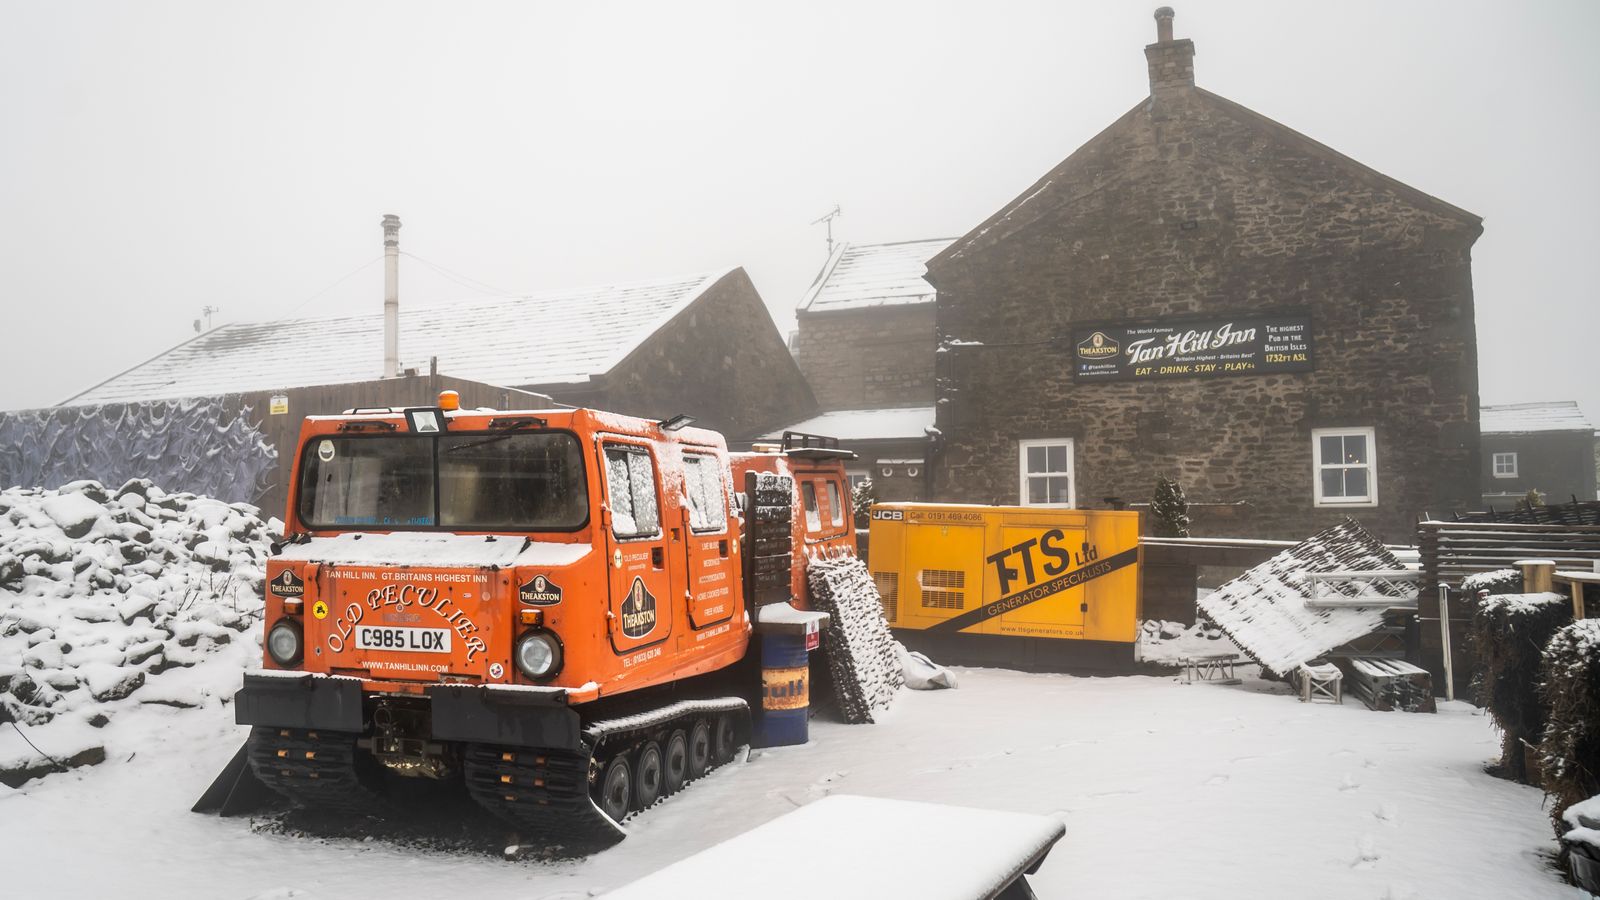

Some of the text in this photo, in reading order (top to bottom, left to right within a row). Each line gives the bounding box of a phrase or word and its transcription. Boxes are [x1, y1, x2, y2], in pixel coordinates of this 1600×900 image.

[1079, 346, 1117, 355] THEAKSTON
[1127, 322, 1257, 366] Tan Hill Inn
[1293, 353, 1307, 361] ASL
[1135, 367, 1152, 376] EAT
[1194, 363, 1217, 373] STAY
[1224, 362, 1247, 371] PLAY
[873, 511, 903, 520] JCB
[986, 528, 1070, 596] FTS
[1075, 545, 1098, 567] Ltd
[325, 570, 341, 579] TAN
[342, 571, 360, 579] HILL
[434, 574, 471, 583] HIGHEST
[473, 575, 488, 583] INN
[271, 584, 304, 593] THEAKSTON
[987, 561, 1112, 616] GENERATOR SPECIALISTS
[520, 591, 560, 601] THEAKSTON
[328, 584, 488, 663] OLD PECULIER
[623, 609, 655, 629] THEAKSTON
[362, 628, 444, 650] C985 LOX
[361, 661, 449, 673] WWW.TANHILLINN.COM
